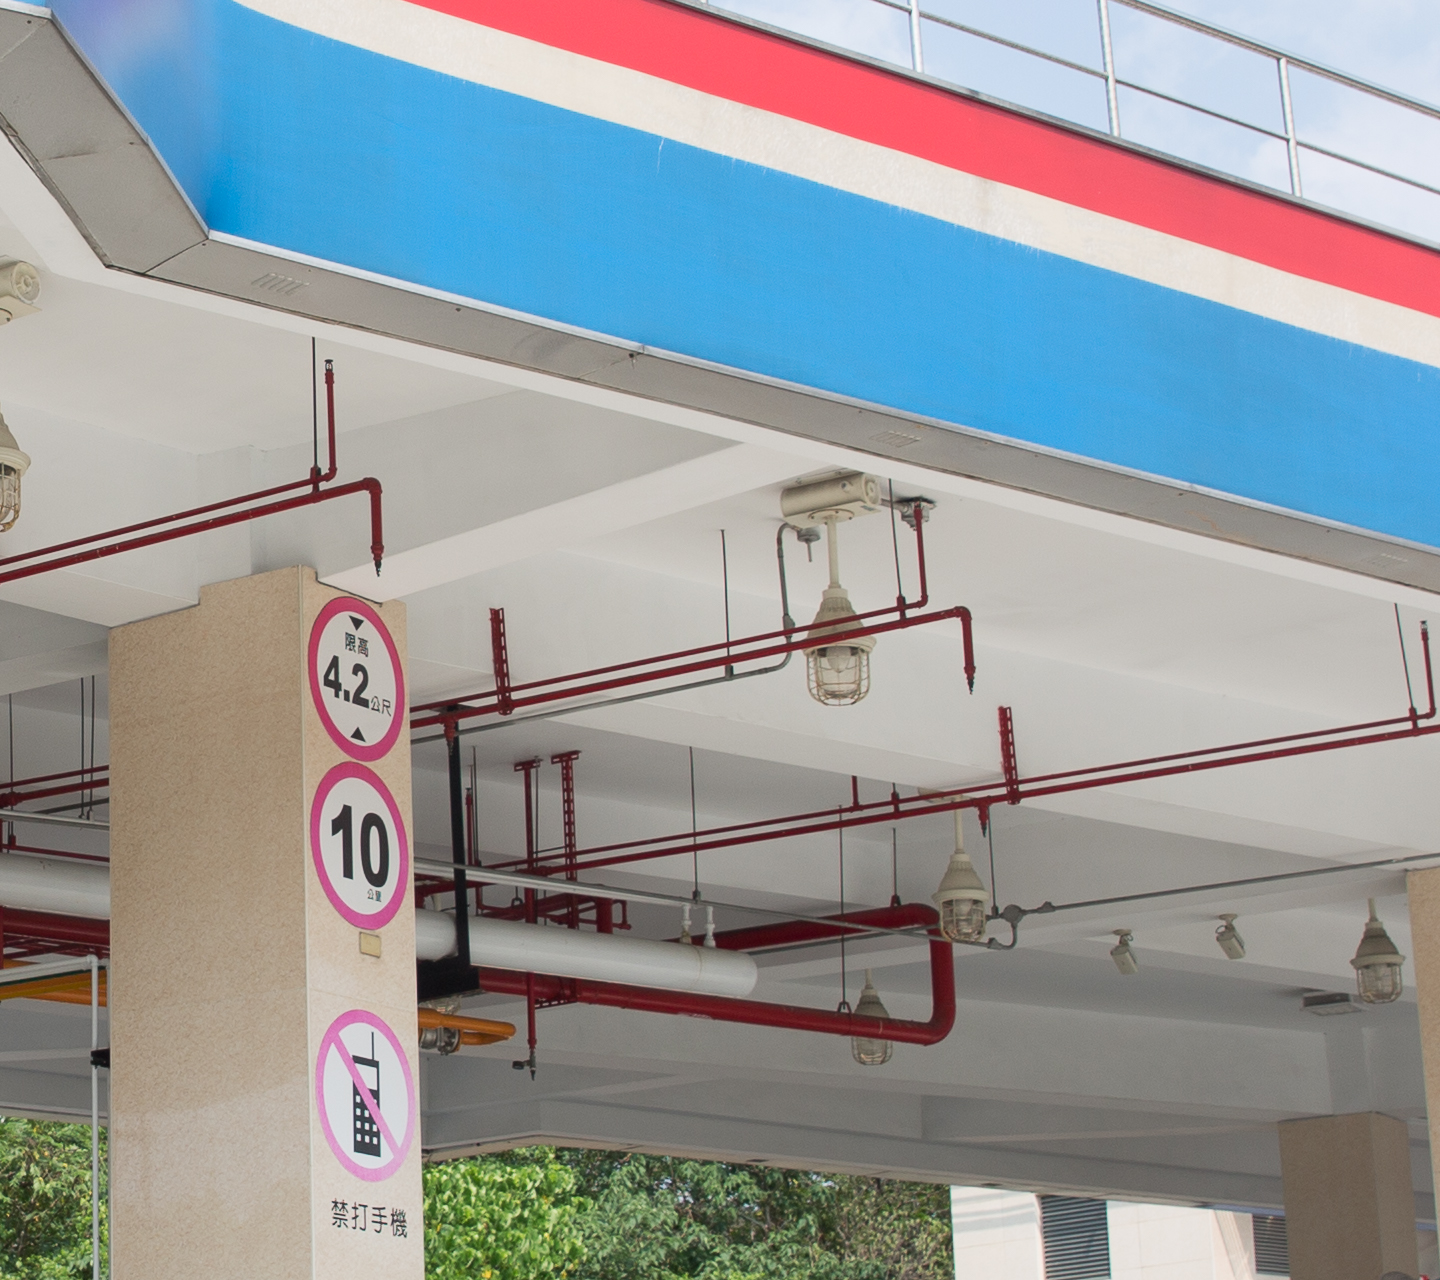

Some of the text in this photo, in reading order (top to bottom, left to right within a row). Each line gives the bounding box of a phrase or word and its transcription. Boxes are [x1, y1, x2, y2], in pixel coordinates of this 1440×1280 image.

[344, 631, 370, 658] 限高
[323, 654, 393, 718] 4.2 公尺
[330, 804, 391, 888] 10
[331, 1197, 410, 1240] 禁打手機
